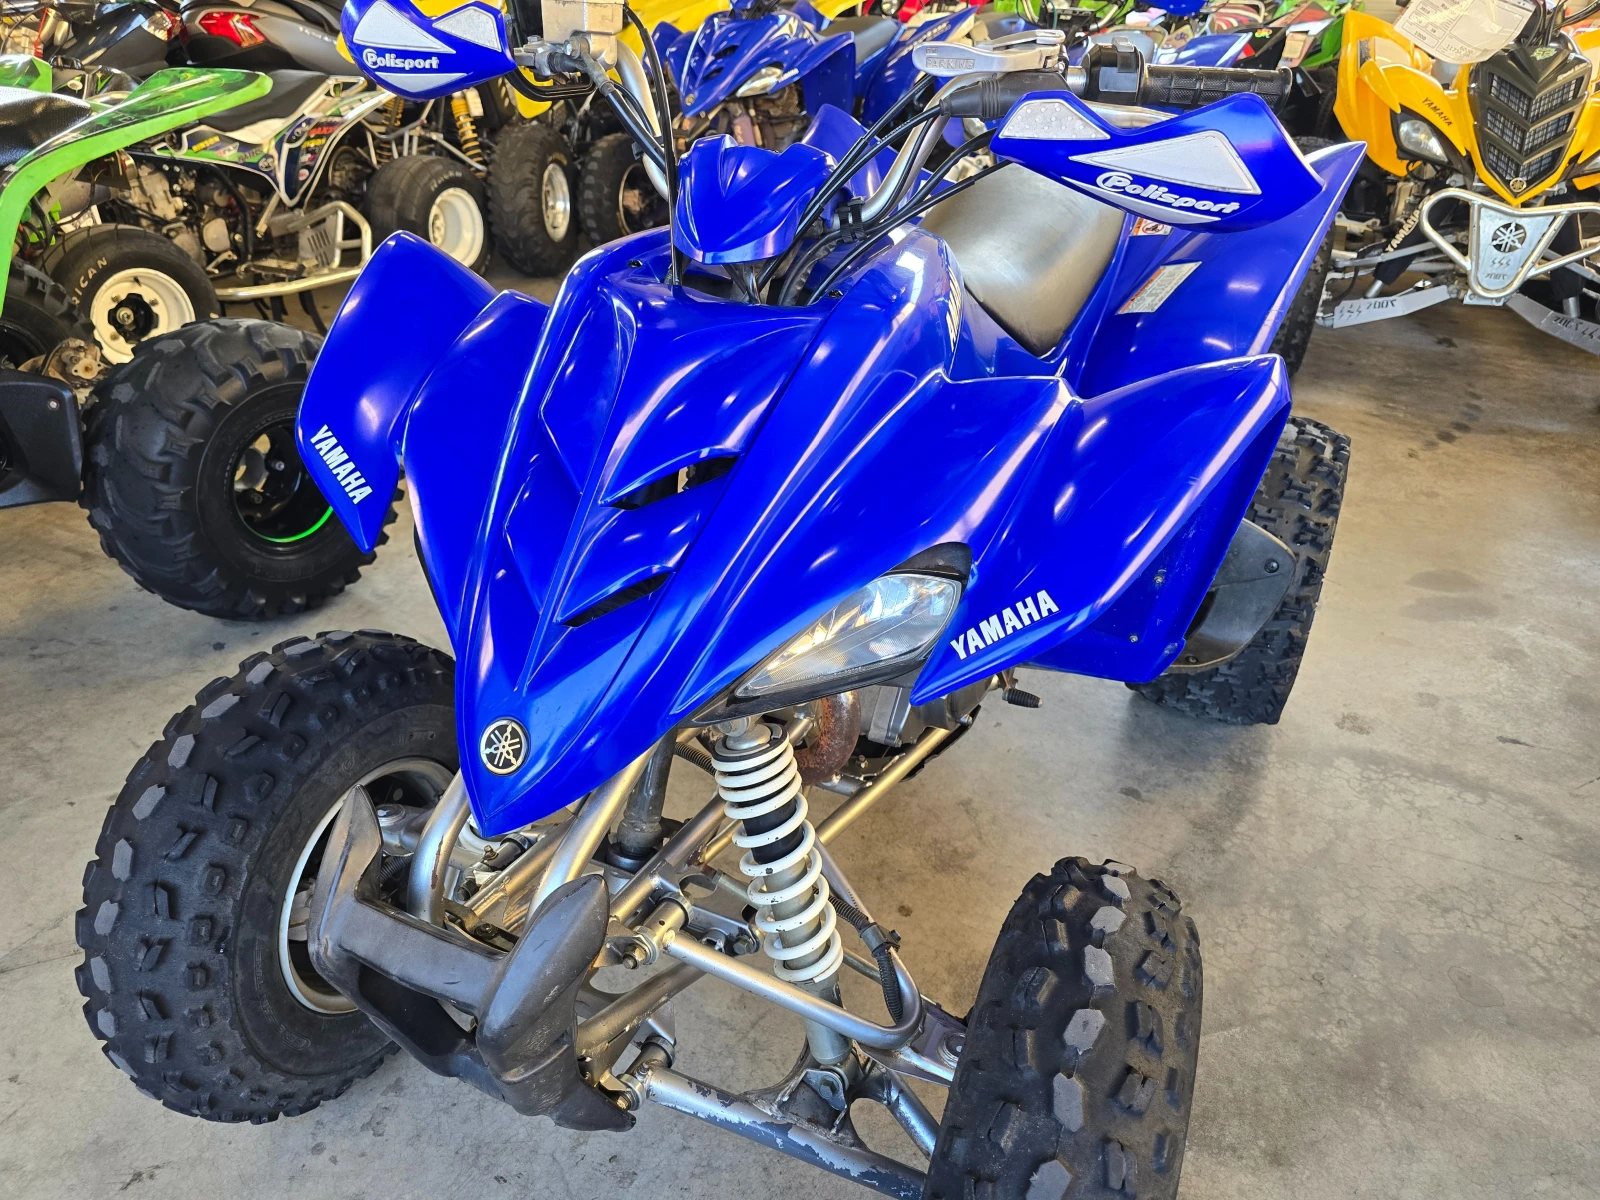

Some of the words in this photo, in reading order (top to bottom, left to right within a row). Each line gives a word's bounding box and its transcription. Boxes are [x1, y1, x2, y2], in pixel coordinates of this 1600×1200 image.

[362, 48, 440, 71] Polisport
[1422, 97, 1453, 126] YAMAHA
[1096, 171, 1240, 214] Polisport
[310, 424, 373, 504] YAMAHA
[950, 589, 1061, 661] YAMAHA
